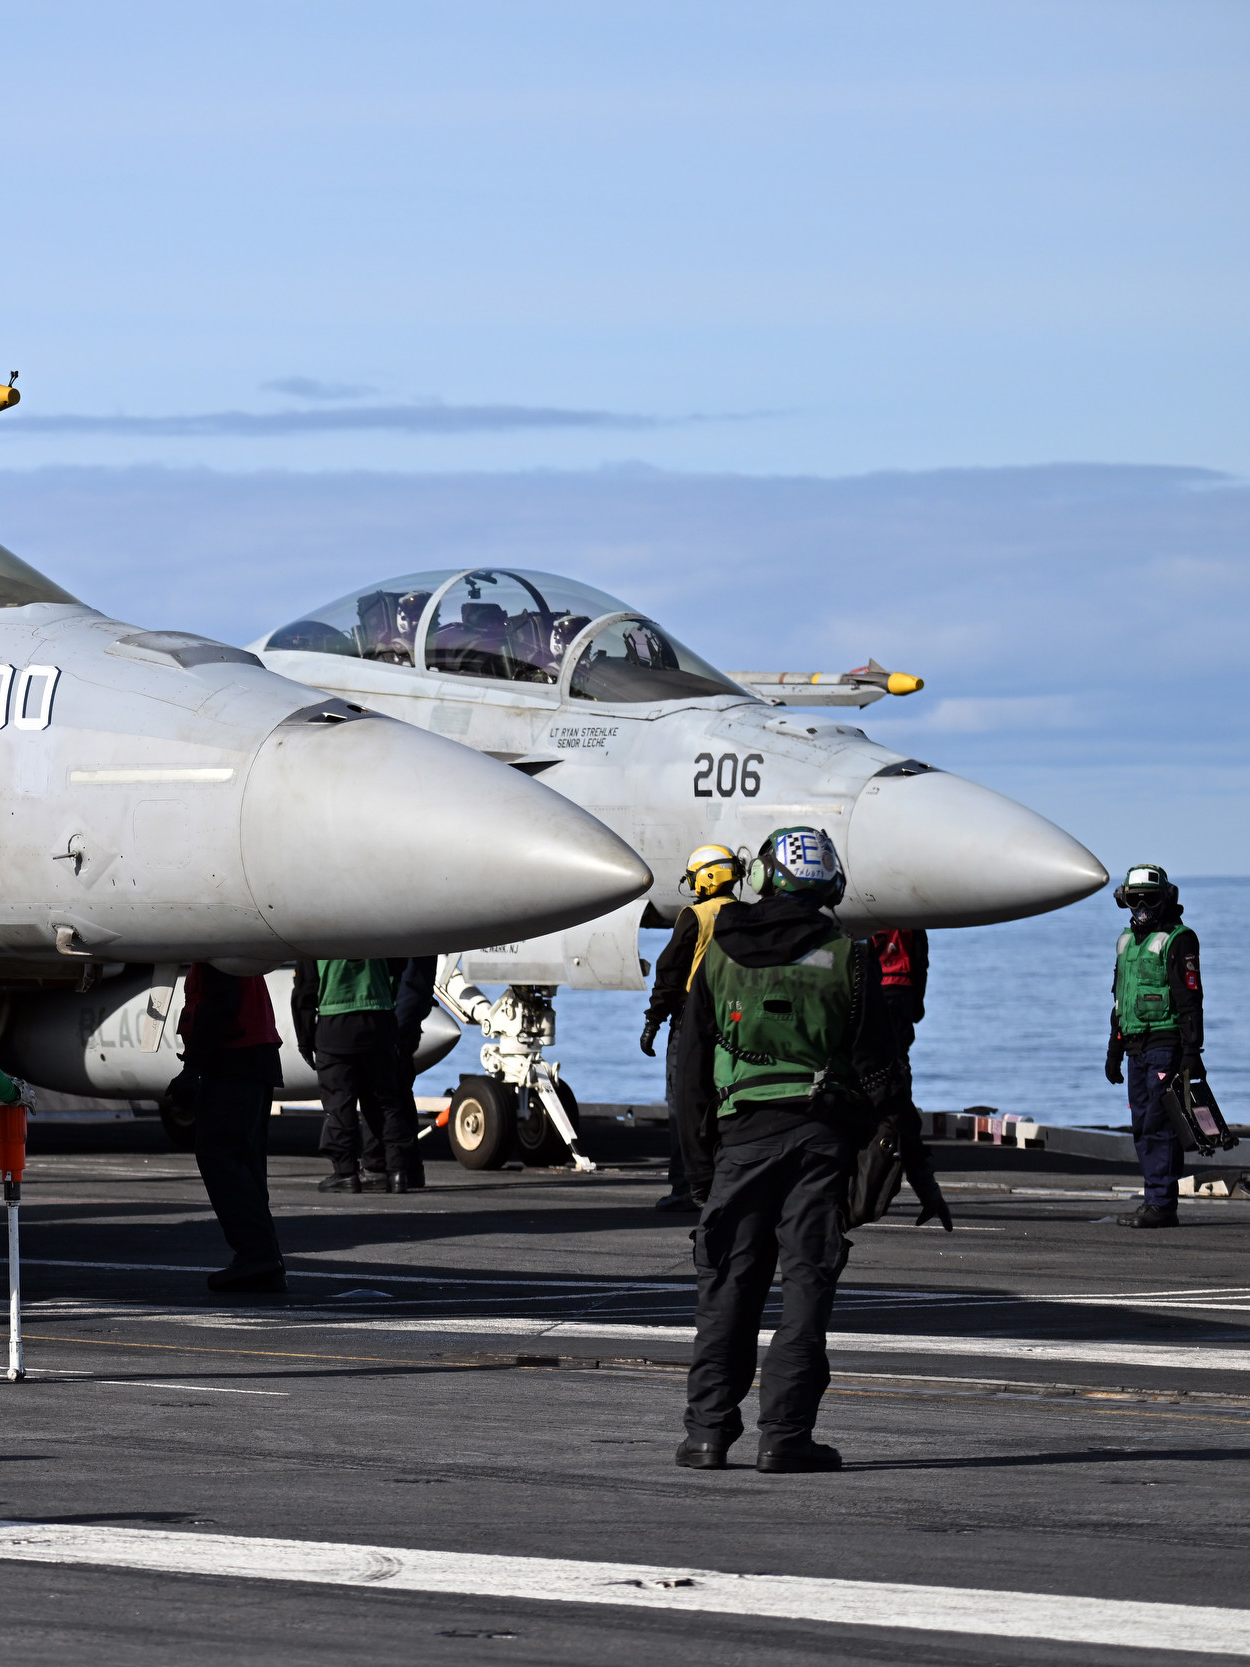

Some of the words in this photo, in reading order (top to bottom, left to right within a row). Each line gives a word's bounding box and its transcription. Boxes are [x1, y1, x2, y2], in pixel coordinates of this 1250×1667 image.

[550, 728, 560, 738] LT
[561, 727, 579, 737] RYAN
[581, 727, 619, 737] STREHLKE
[557, 738, 580, 748] SENOR
[582, 738, 606, 748] LECHE
[693, 752, 764, 798] 206
[800, 834, 822, 865] E
[510, 944, 519, 954] NJ
